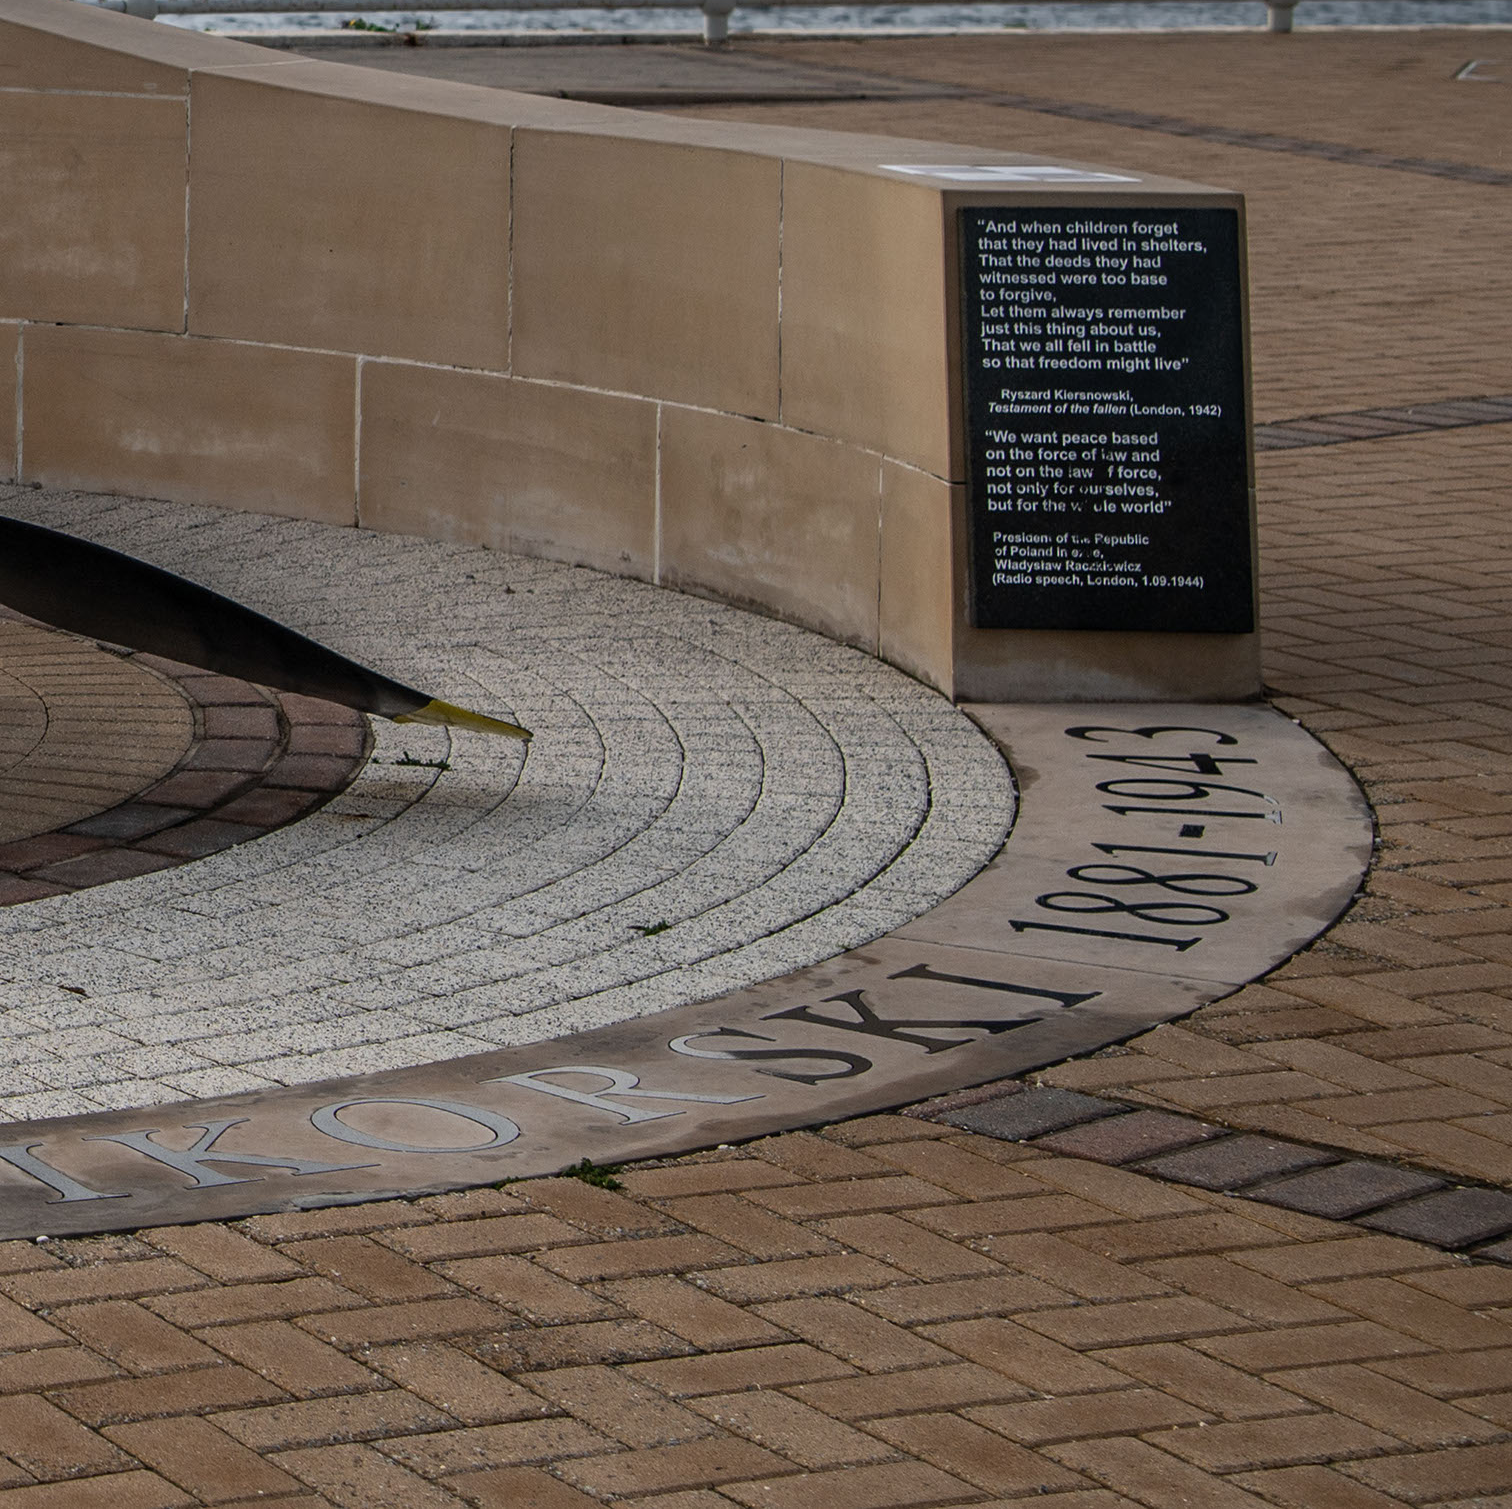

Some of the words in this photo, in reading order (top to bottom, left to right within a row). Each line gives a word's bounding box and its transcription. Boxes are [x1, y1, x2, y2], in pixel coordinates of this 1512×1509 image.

[976, 219, 1016, 233] “And
[1020, 220, 1061, 234] when
[1065, 220, 1128, 234] children
[1131, 220, 1178, 237] forget
[977, 236, 1008, 250] that
[1011, 236, 1044, 253] they
[1048, 237, 1077, 250] had
[1081, 237, 1118, 251] lived
[1122, 237, 1136, 251] in
[1140, 237, 1207, 253] shelters,
[977, 253, 1013, 267] That
[1015, 254, 1040, 267] the
[1044, 253, 1091, 268] deeds
[1094, 254, 1128, 271] they
[1132, 254, 1161, 268] had
[978, 270, 1056, 284] witnessed
[1059, 273, 1097, 285] were
[1100, 272, 1127, 285] too
[1130, 271, 1167, 286] base
[979, 288, 995, 301] to
[998, 287, 1056, 304] forgive,
[980, 304, 1004, 318] Let
[1008, 304, 1047, 318] them
[1050, 304, 1104, 322] always
[1107, 306, 1186, 319] remember
[981, 357, 1001, 368] so
[1004, 354, 1035, 369] that
[1037, 355, 1102, 369] freedom
[1105, 356, 1151, 373] might
[1154, 356, 1189, 370] live”
[1000, 388, 1051, 402] Ryszard
[1053, 388, 1134, 402] Kiersnowski,
[984, 429, 1017, 443] “We
[1020, 430, 1058, 444] want
[1061, 433, 1108, 447] peace
[1111, 431, 1158, 445] based
[1008, 726, 1282, 953] 1881-1943
